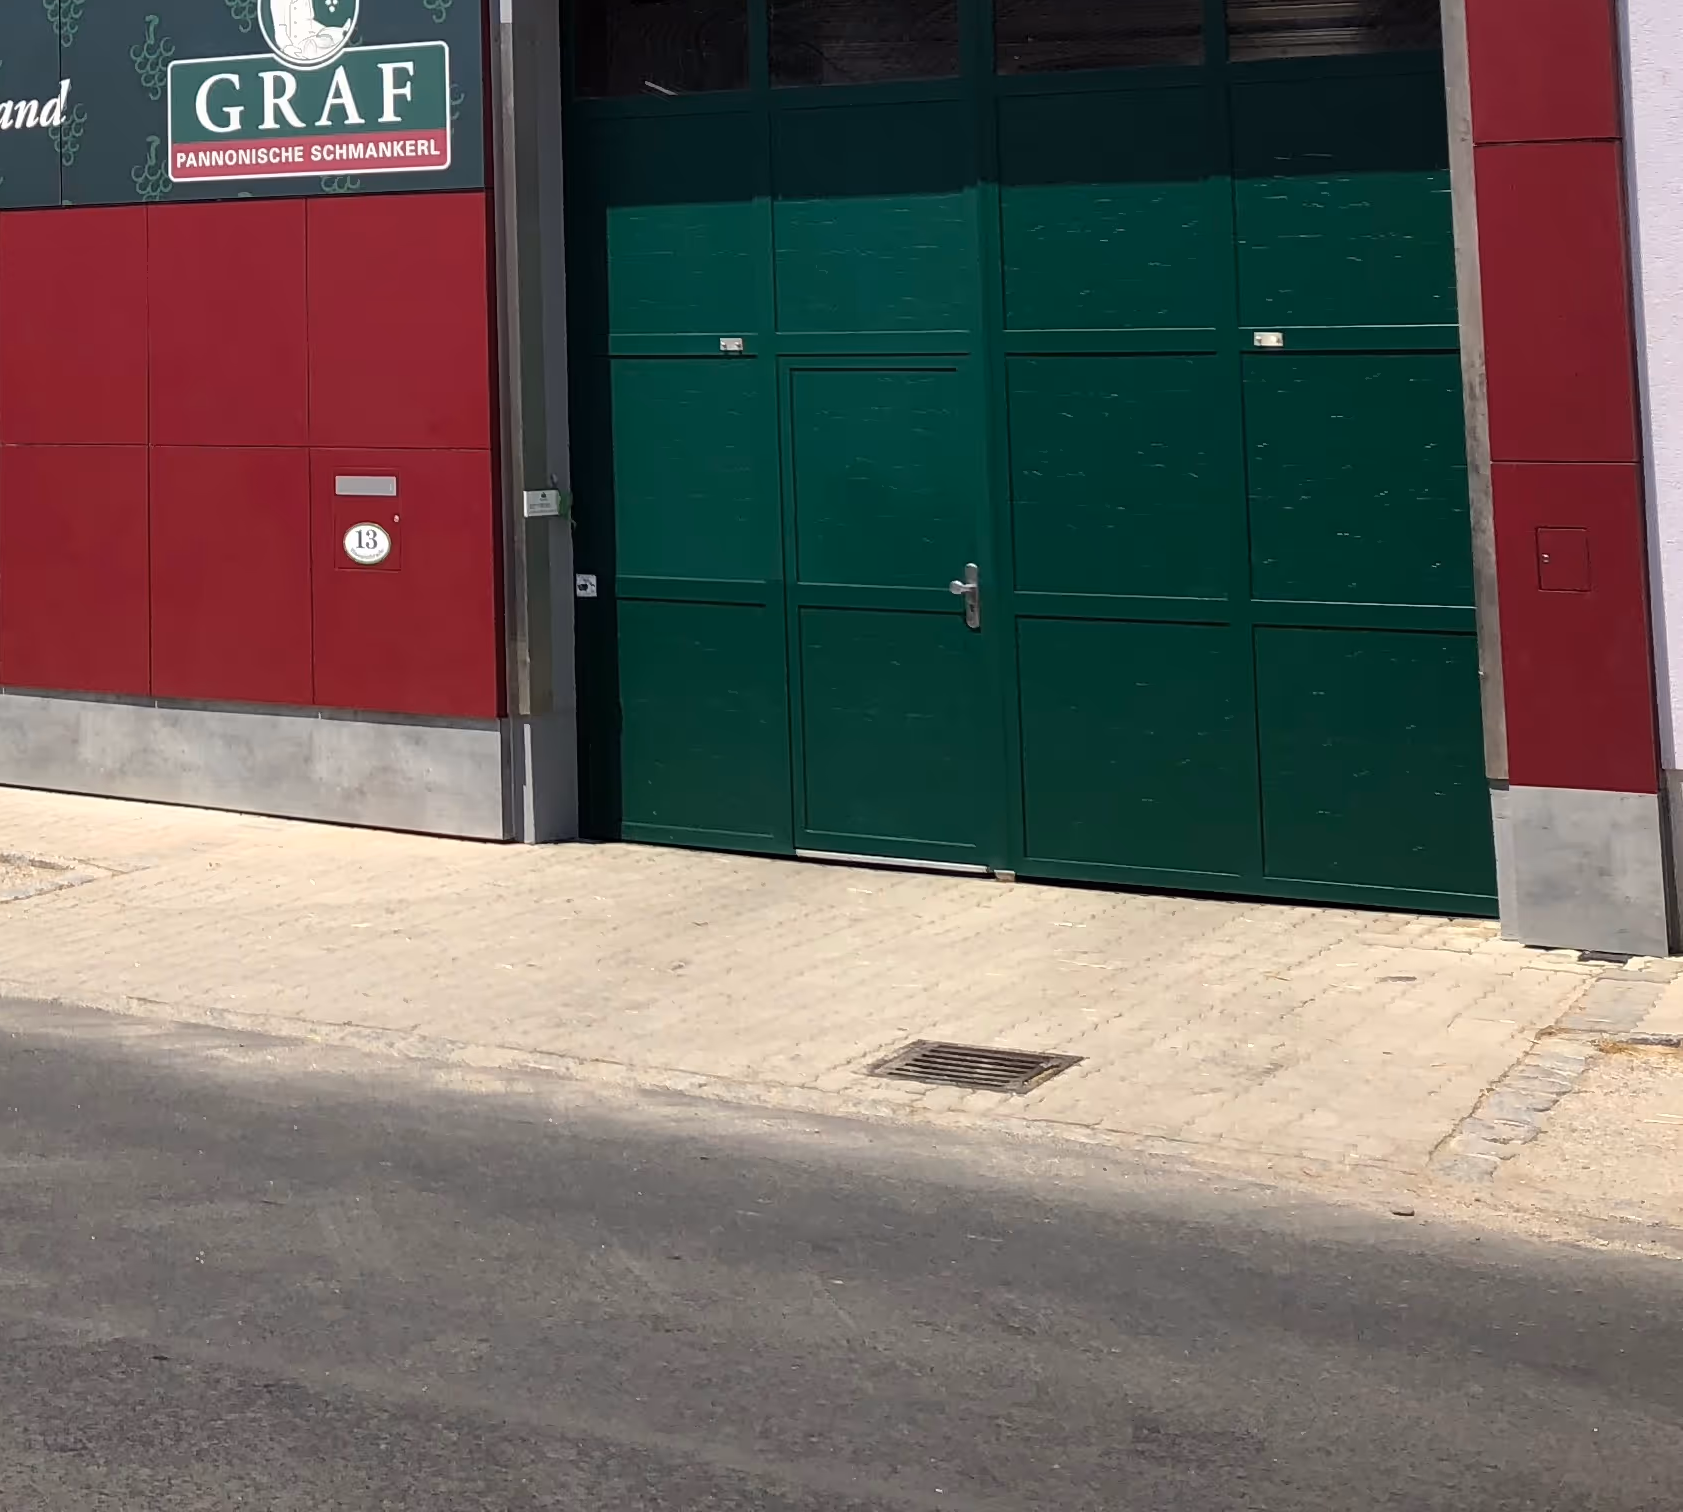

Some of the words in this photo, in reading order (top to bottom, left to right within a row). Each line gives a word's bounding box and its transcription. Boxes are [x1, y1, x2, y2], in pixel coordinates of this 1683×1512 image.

[194, 61, 415, 133] GRAF
[176, 145, 304, 169] PANNONISCHE
[310, 138, 441, 162] SCHMANKERL
[355, 529, 378, 549] 13
